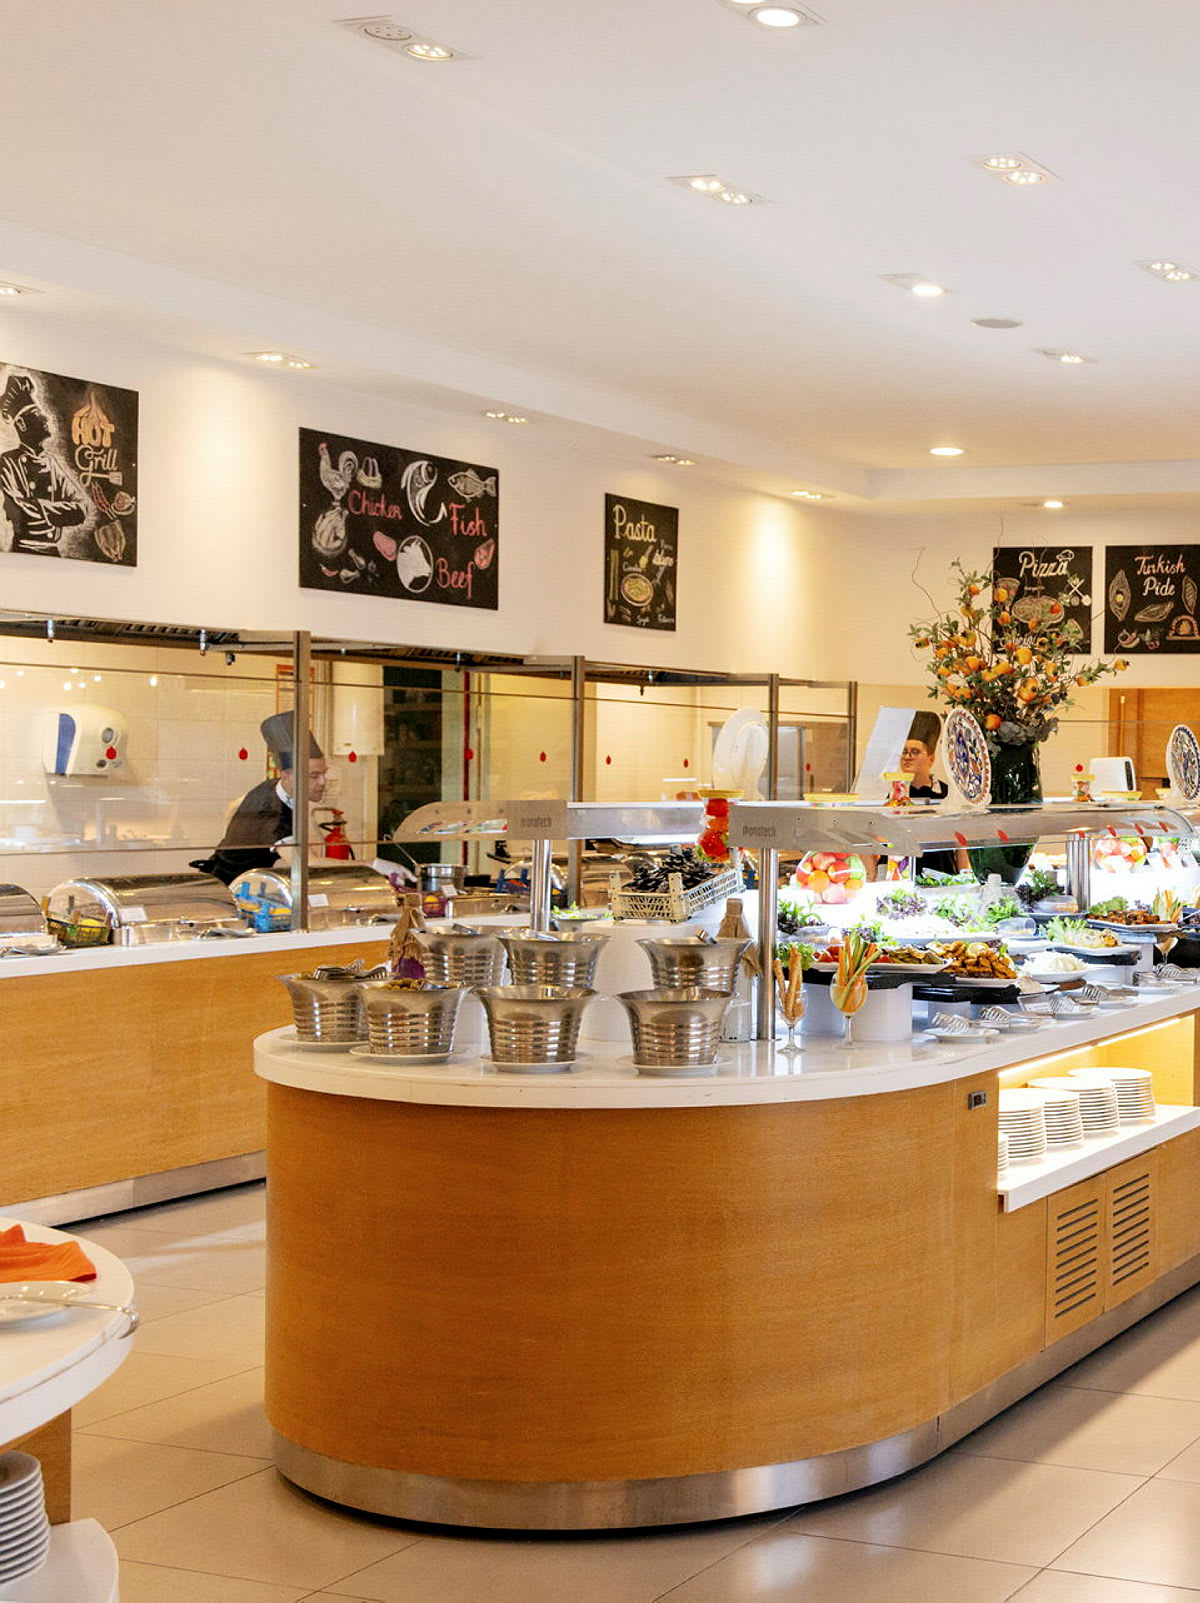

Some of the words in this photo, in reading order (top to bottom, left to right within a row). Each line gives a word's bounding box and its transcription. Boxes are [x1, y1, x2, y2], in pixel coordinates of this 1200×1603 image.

[72, 400, 115, 447] HOT
[75, 444, 118, 487] Grill
[348, 489, 402, 520] Chicken
[450, 503, 487, 536] Fish
[612, 503, 657, 542] Pasta
[436, 557, 475, 599] Beef
[1019, 551, 1069, 577] Pizza
[1134, 554, 1186, 576] Turkish
[1142, 577, 1175, 597] Pide
